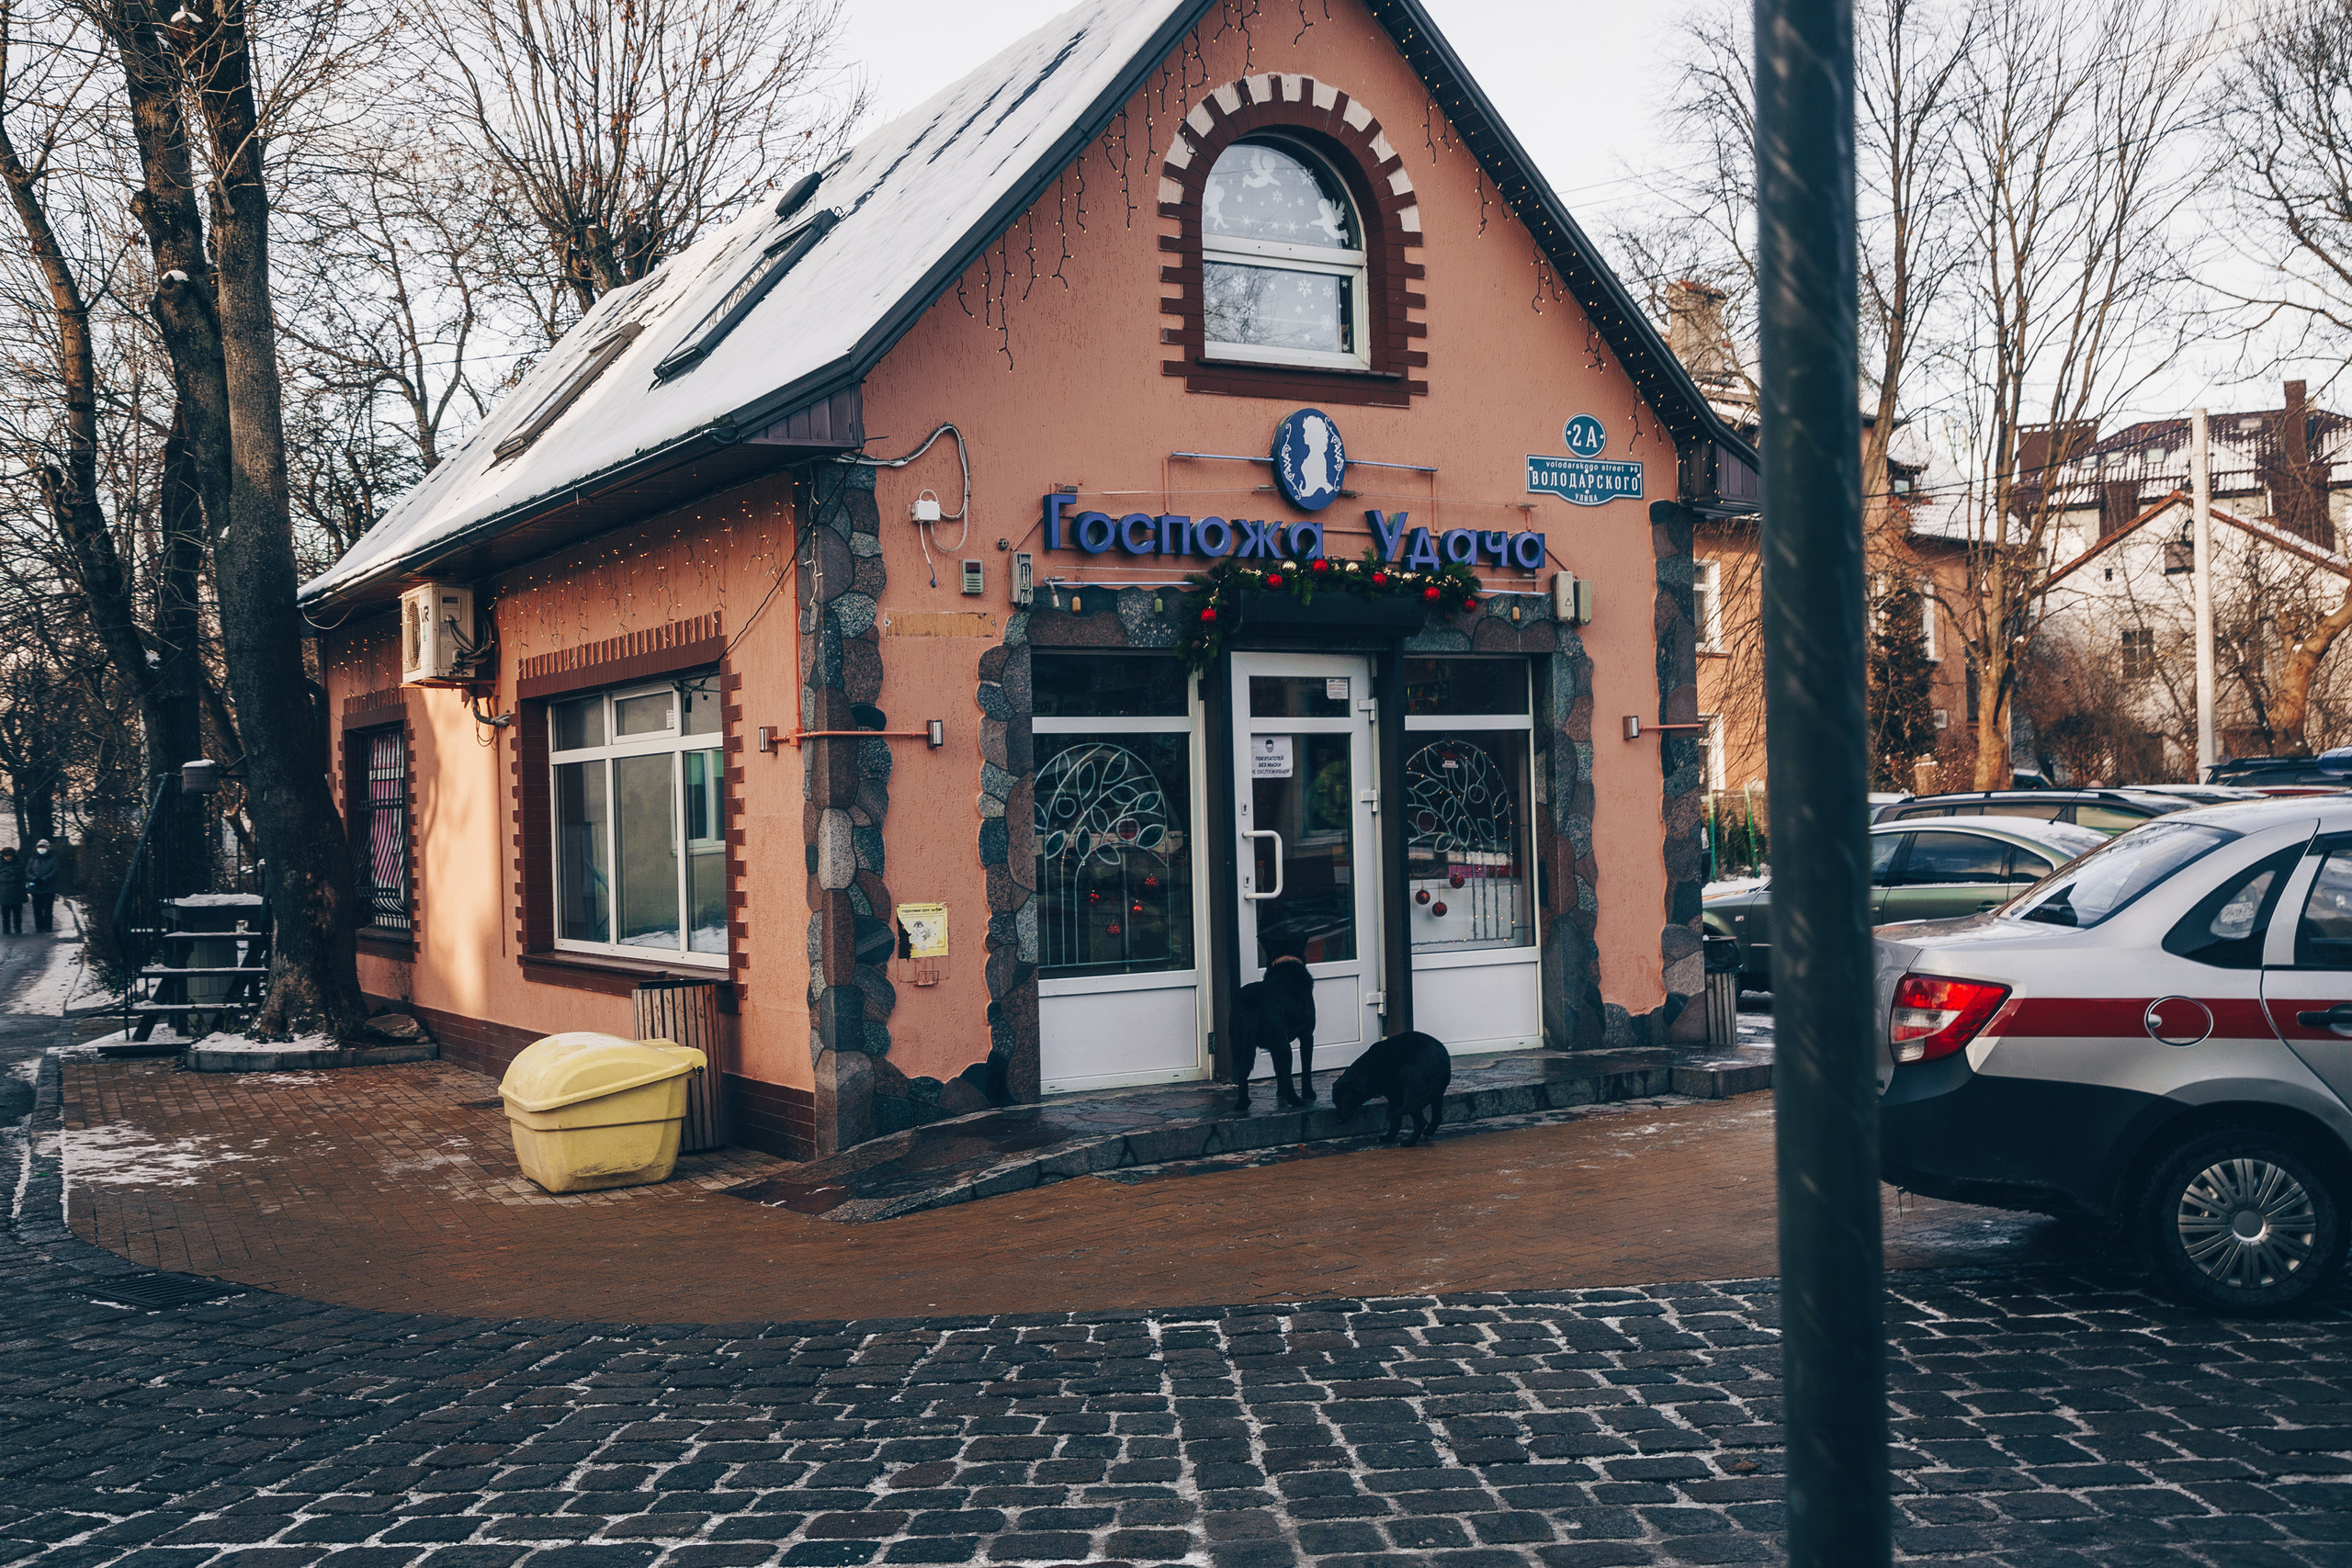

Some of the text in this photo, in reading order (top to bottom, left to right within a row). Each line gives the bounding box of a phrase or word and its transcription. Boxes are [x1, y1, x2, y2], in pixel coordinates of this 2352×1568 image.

[1572, 423, 1598, 448] 2А
[1545, 461, 1599, 472] volodarskogo
[1532, 470, 1638, 491] ВОЛОДАРСКОГО
[1575, 492, 1599, 502] УЛИЦА
[1043, 493, 1545, 571] Госпожа Удача
